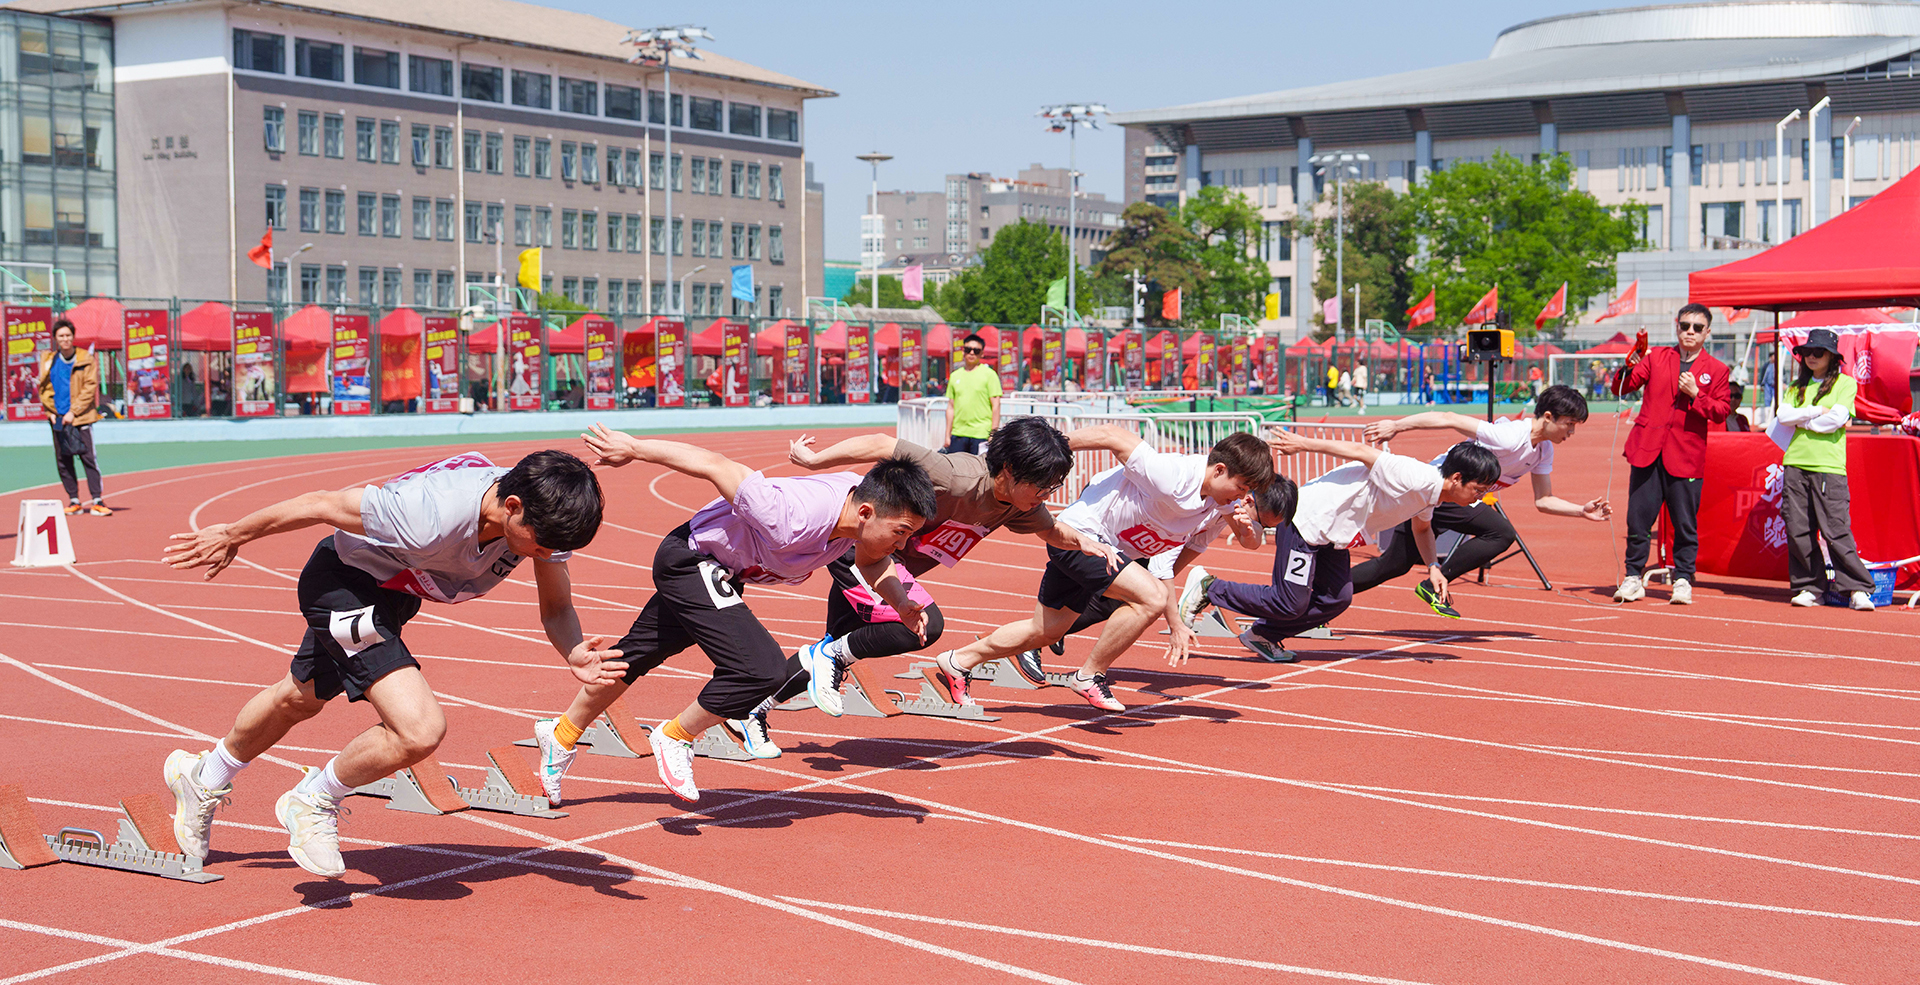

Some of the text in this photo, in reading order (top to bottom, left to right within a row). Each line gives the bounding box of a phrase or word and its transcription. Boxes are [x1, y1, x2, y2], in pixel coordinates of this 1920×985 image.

[36, 516, 59, 555] 1
[929, 528, 975, 558] 1491
[1290, 557, 1307, 577] 2
[338, 612, 365, 645] 7
